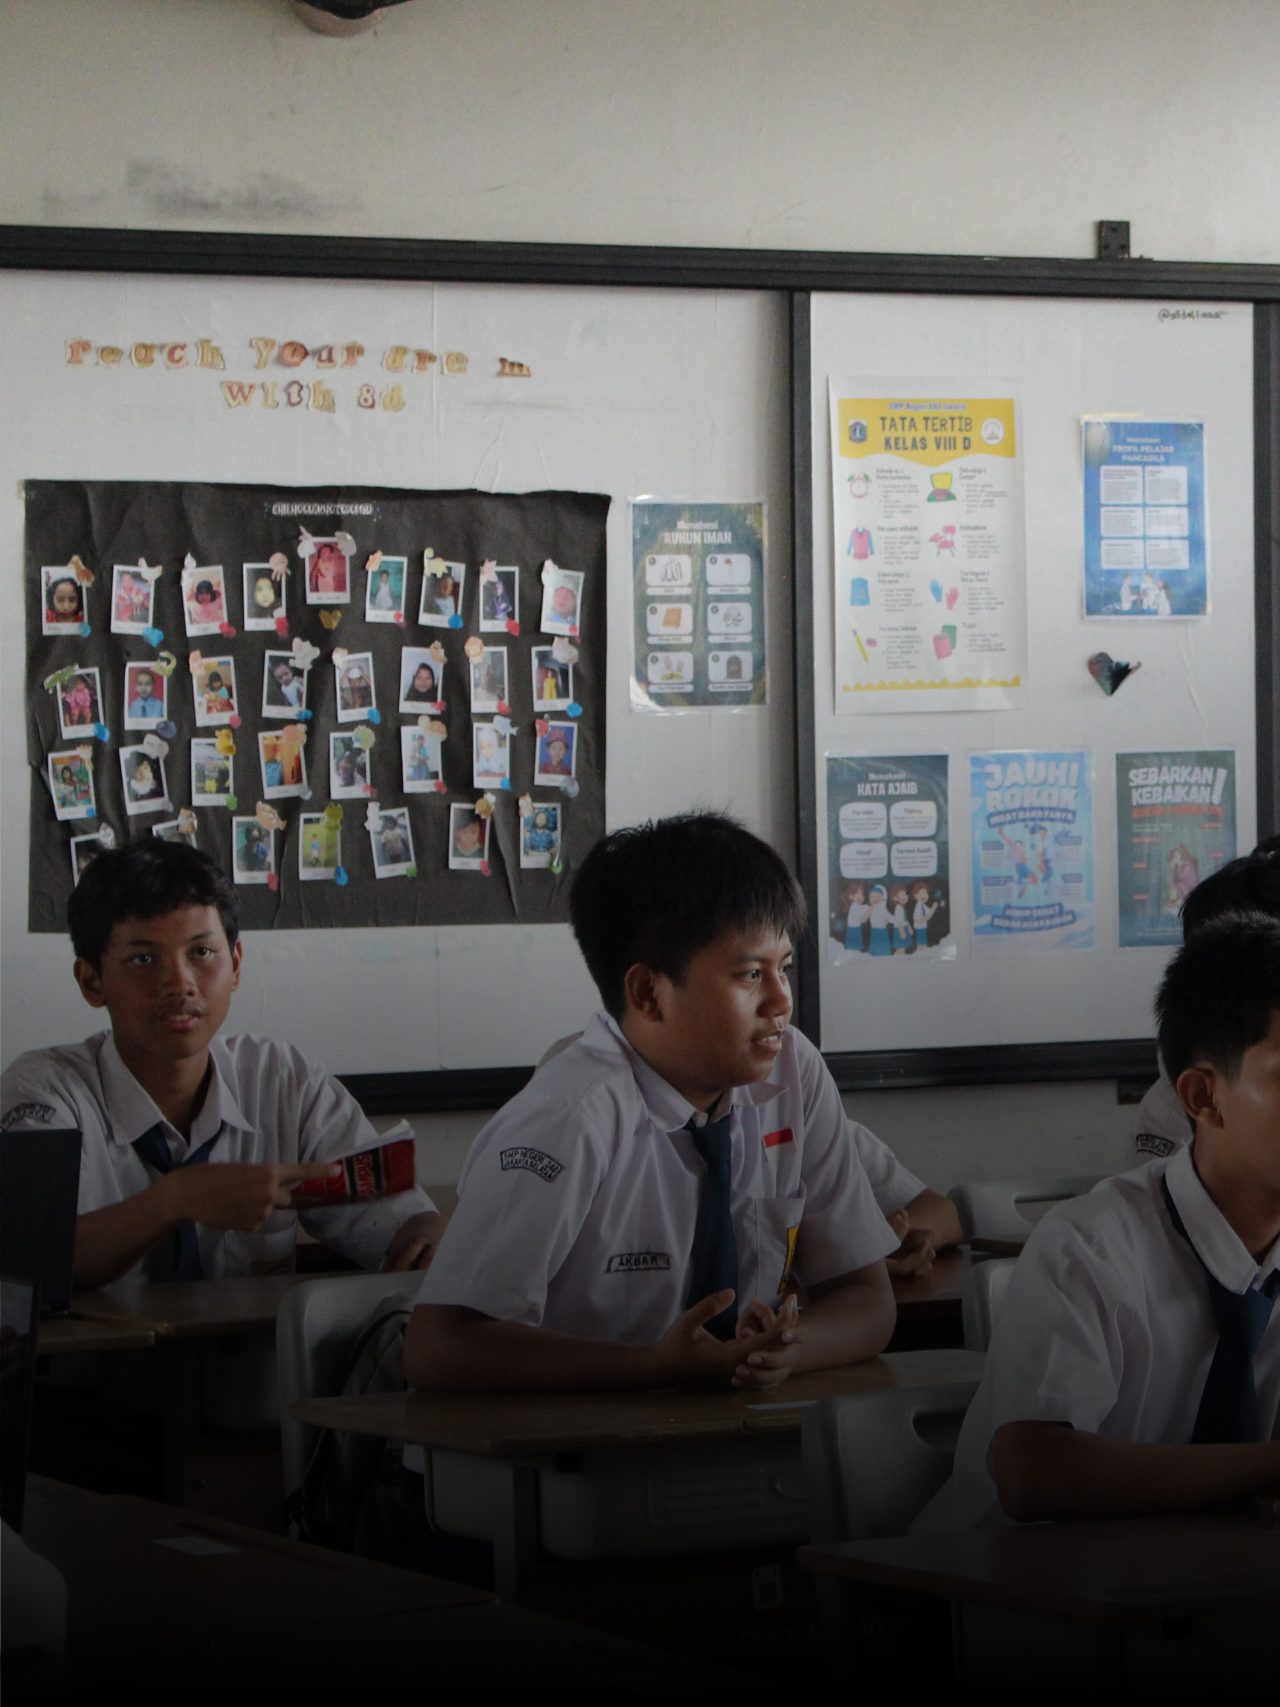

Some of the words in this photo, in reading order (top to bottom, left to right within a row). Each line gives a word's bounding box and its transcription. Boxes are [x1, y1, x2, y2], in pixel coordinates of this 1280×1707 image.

[221, 380, 335, 412] with
[879, 417, 917, 432] TATA
[923, 416, 973, 433] TERTIB
[884, 437, 928, 451] KELAS
[934, 437, 957, 450] VIII
[963, 437, 972, 450] D
[664, 531, 701, 544] RUKUN
[703, 531, 733, 544] IMAN
[984, 761, 1080, 789] JAUHI
[1129, 765, 1213, 787] SEBARKAN
[857, 783, 886, 796] KATA
[888, 782, 918, 795] AJAIB
[986, 788, 1079, 811] ROKOK
[618, 1255, 658, 1267] AKBAR
